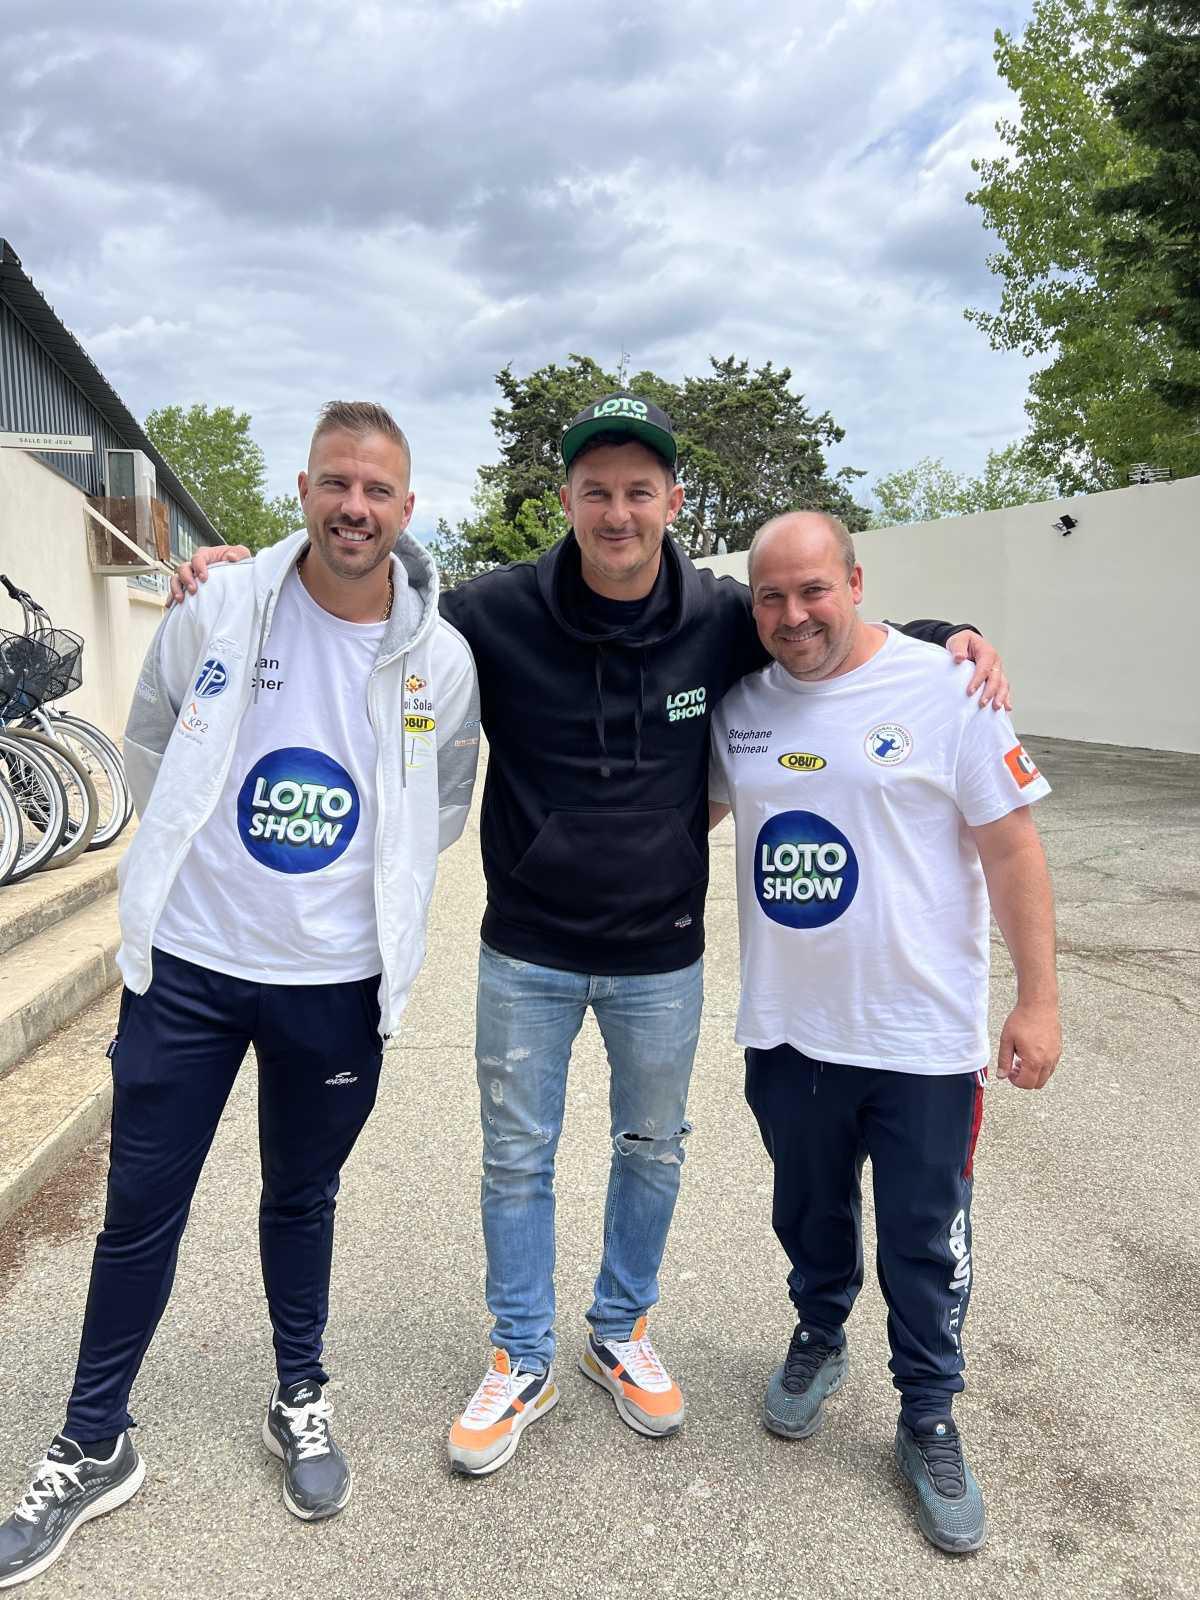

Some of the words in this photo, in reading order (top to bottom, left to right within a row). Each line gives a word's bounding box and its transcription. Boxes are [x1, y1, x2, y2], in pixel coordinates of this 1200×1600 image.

[593, 397, 648, 418] LOTO
[254, 658, 279, 670] an
[666, 686, 706, 710] LOTO
[668, 702, 706, 722] SHOW
[728, 729, 772, 741] Stéphane
[727, 743, 768, 754] Robineau
[788, 755, 818, 768] OBUT
[251, 776, 353, 818] LOTO
[248, 812, 343, 847] SHOW
[761, 842, 848, 873] LOTO
[762, 876, 844, 901] SHOW
